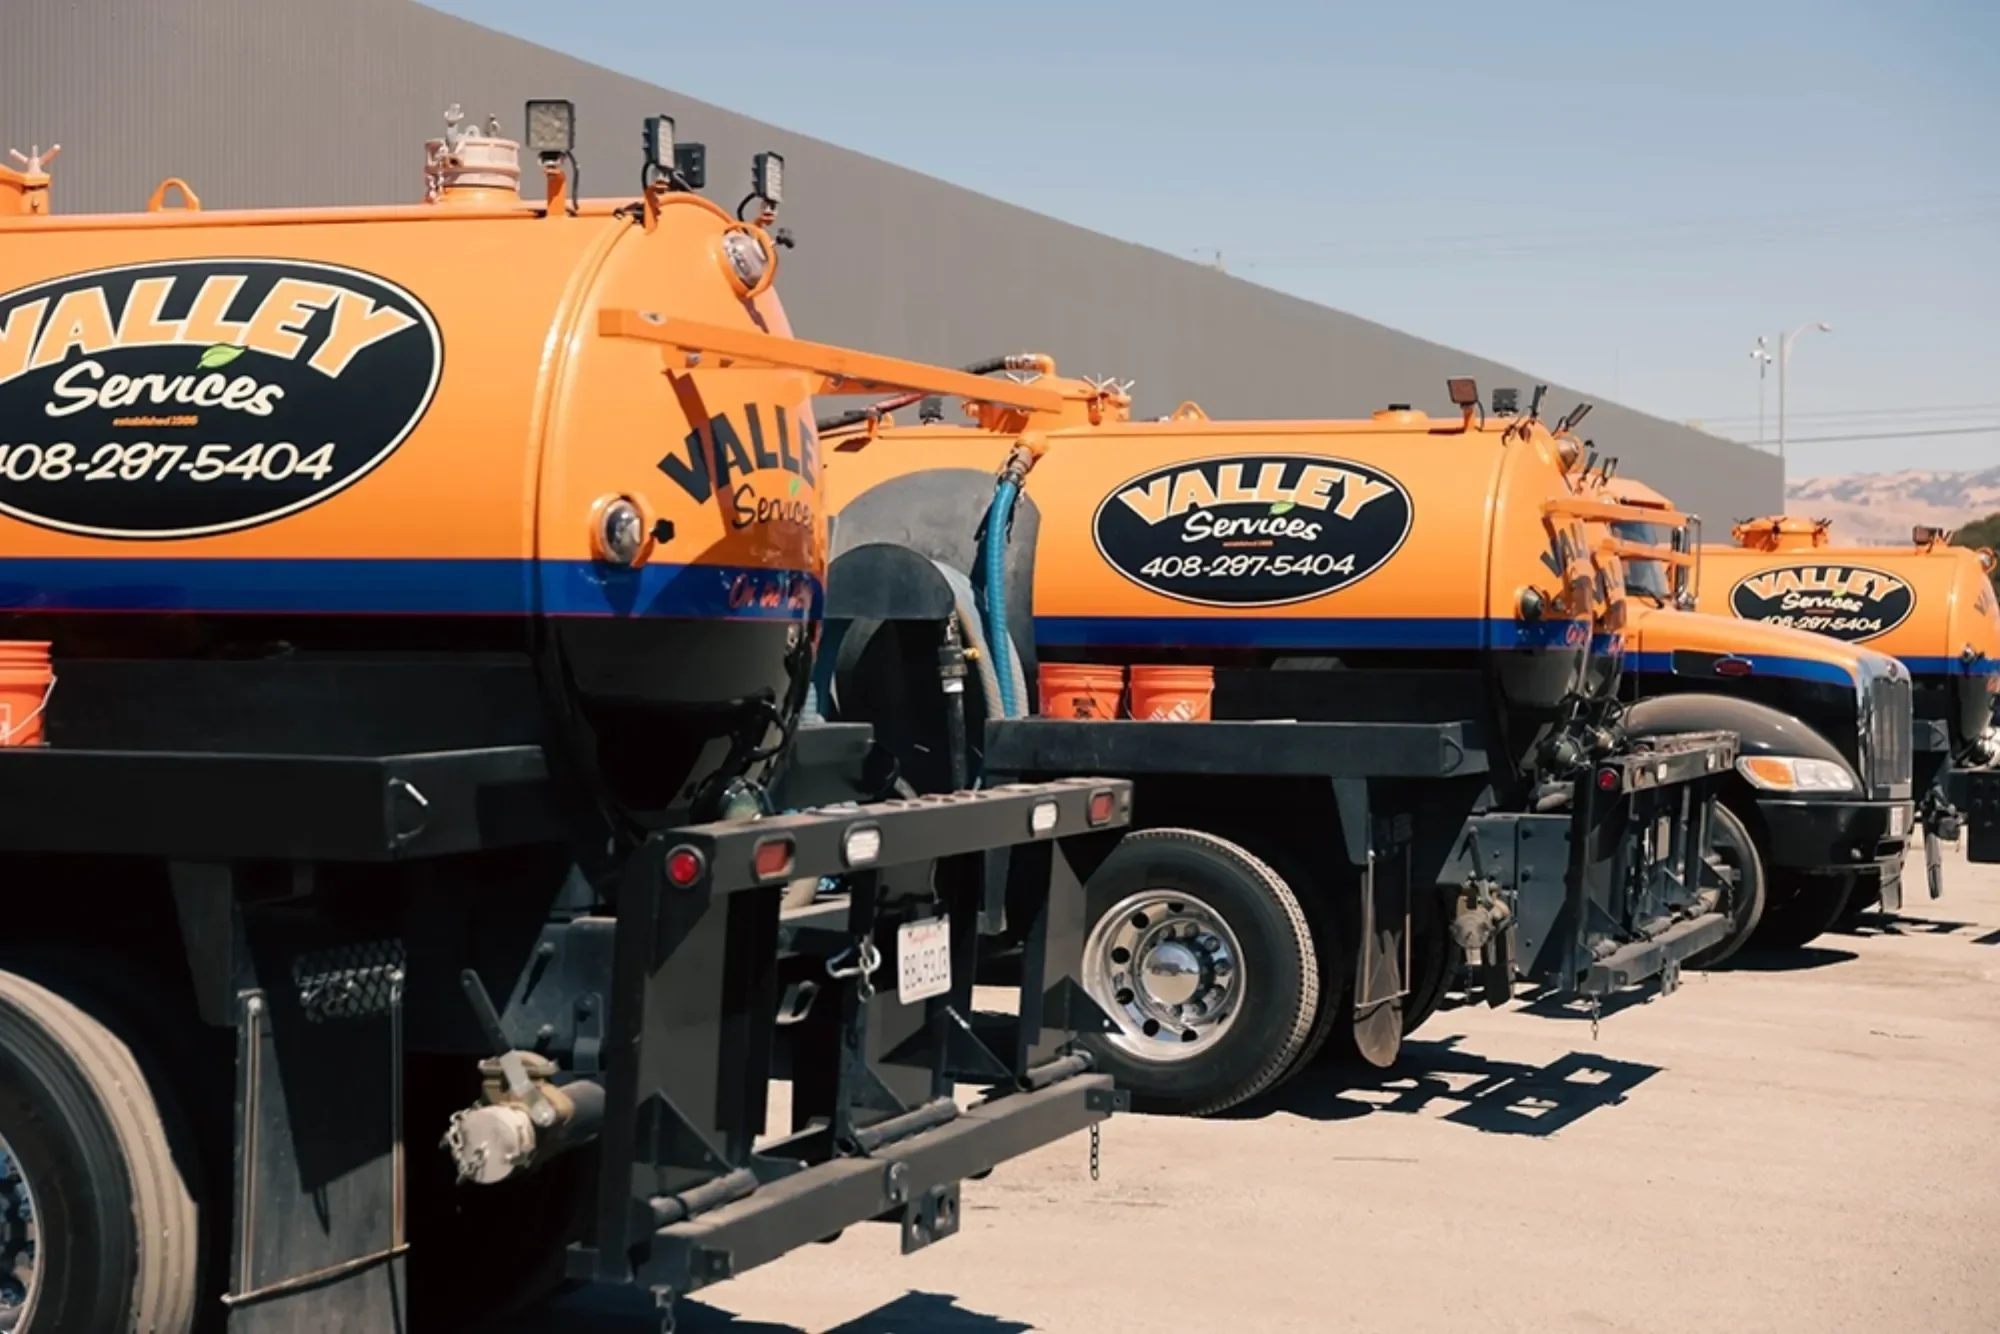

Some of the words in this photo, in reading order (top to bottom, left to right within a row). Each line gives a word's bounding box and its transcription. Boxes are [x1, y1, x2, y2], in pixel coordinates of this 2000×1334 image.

[45, 360, 284, 417] Services
[0, 442, 336, 481] 08-297-5404
[656, 402, 815, 504] VALLE
[1117, 463, 1395, 526] VALLEY
[1181, 510, 1322, 543] Services
[1140, 553, 1355, 577] 408-297-5404
[1745, 568, 1904, 602] VALLEY
[1780, 592, 1863, 613] Services
